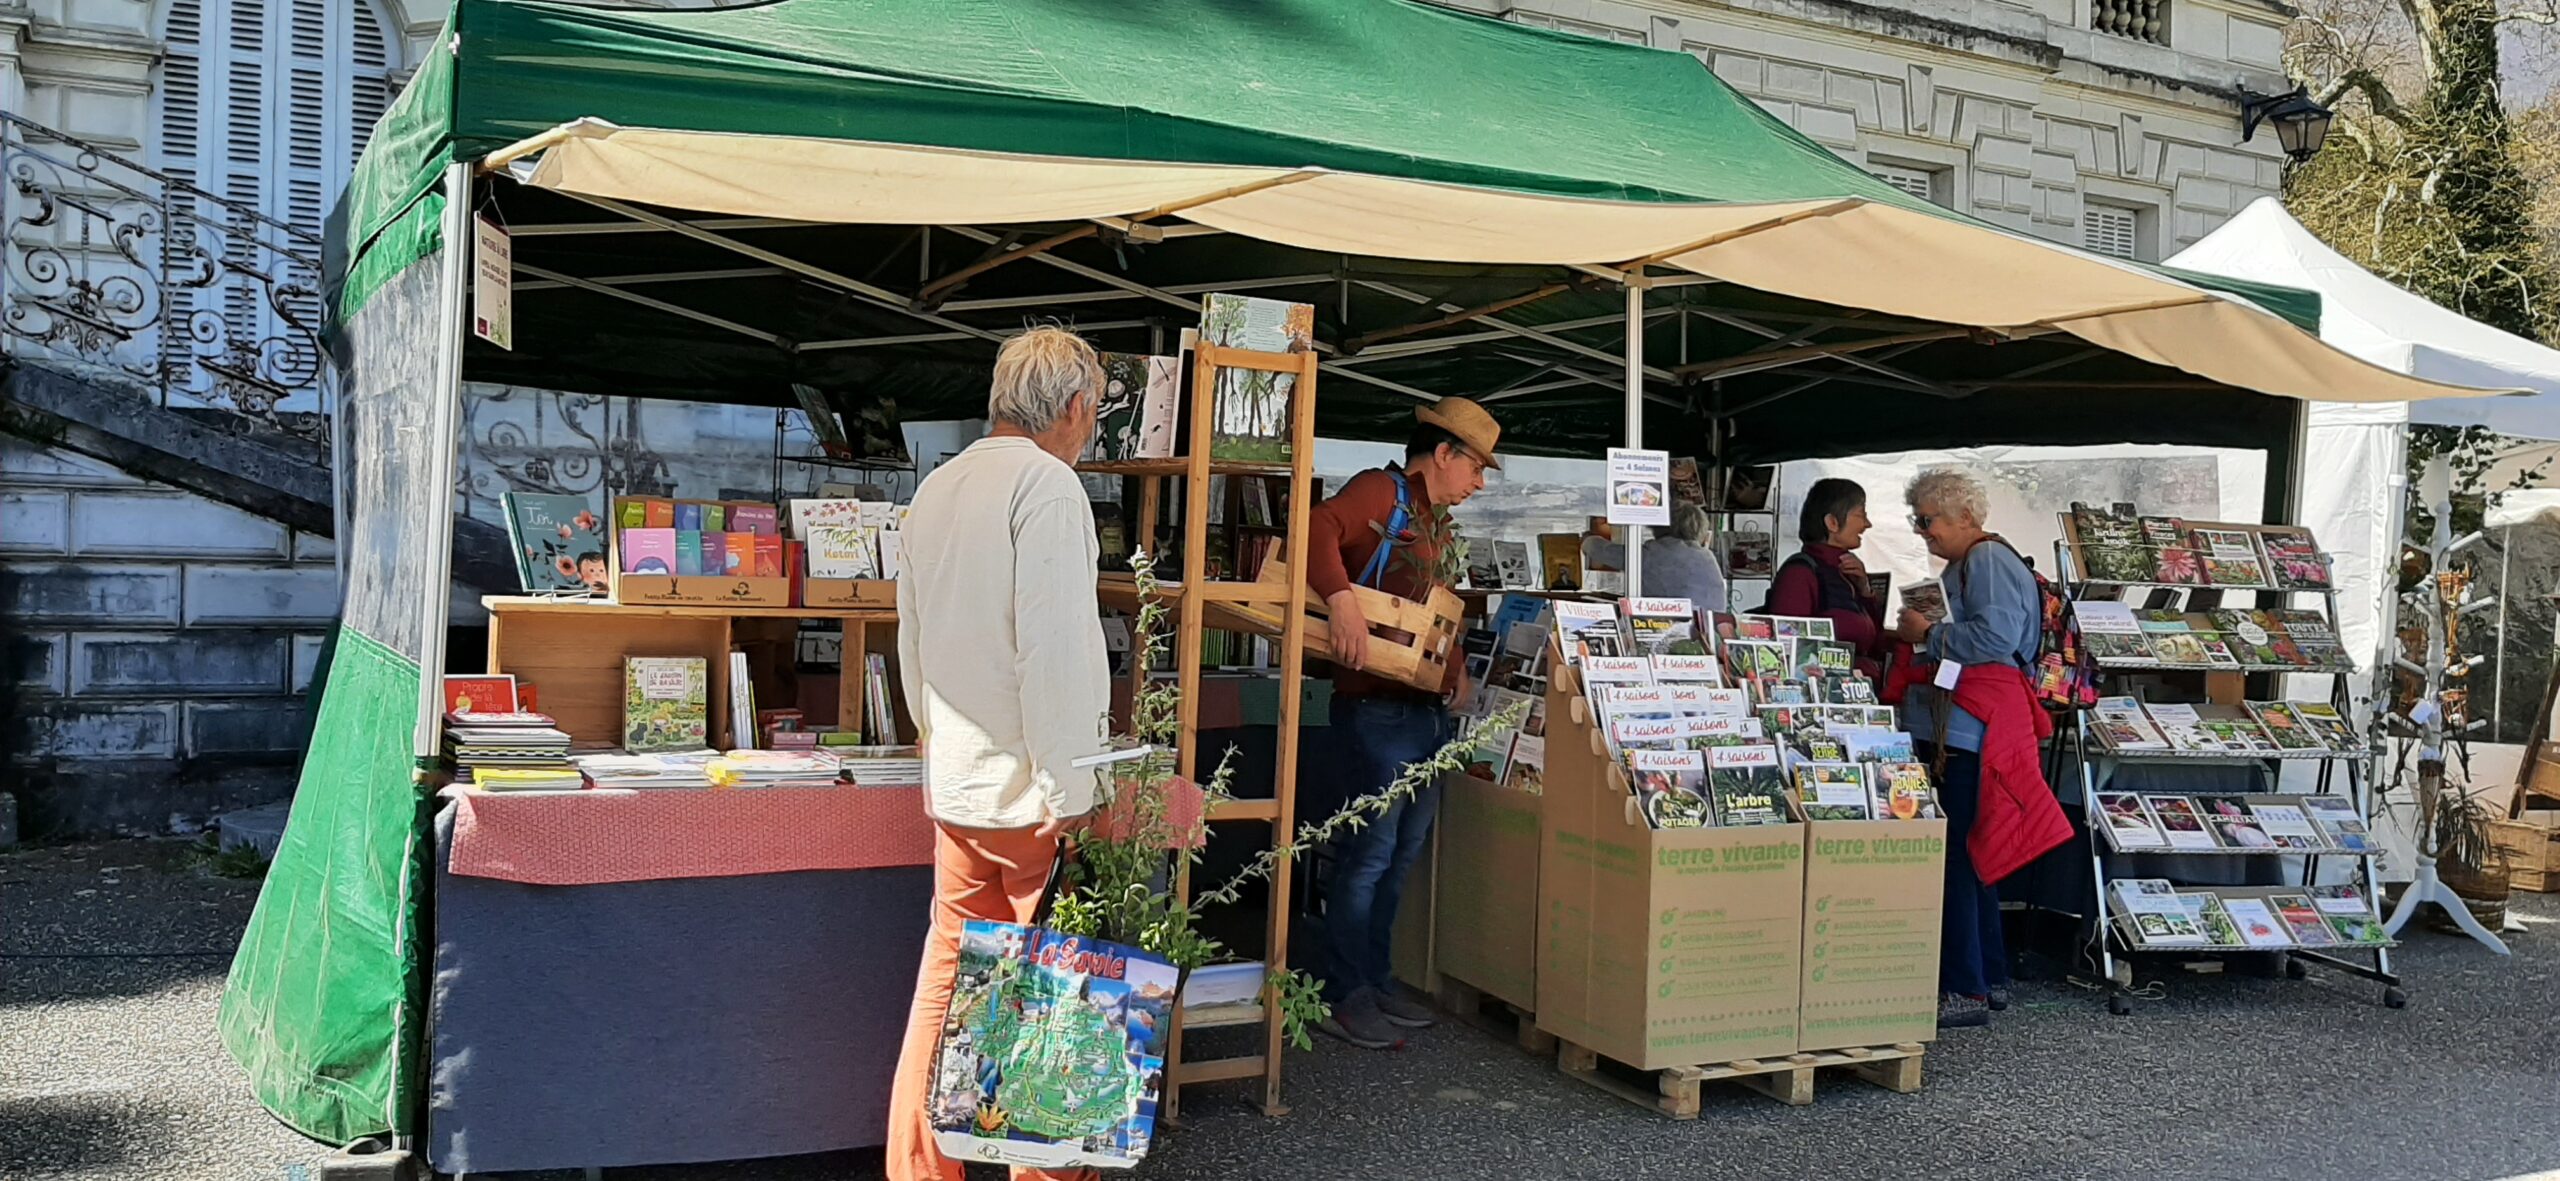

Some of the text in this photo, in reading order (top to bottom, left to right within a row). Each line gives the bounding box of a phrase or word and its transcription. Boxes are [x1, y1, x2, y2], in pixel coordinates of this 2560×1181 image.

[524, 507, 553, 526] Toi
[1565, 603, 1602, 620] Village
[1635, 600, 1684, 613] 4 saisons
[1593, 660, 1639, 671] 4 saisons
[1660, 657, 1706, 669] 4 saisons
[1615, 689, 1660, 701] 4 saisons
[1672, 689, 1696, 700] isons
[1841, 682, 1870, 699] STOP
[1623, 723, 1676, 736] 4 saisons
[1687, 718, 1729, 732] saisons
[1640, 753, 1693, 766] 4 saisons
[1716, 750, 1766, 763] 4 saisons
[1726, 792, 1772, 808] L'arbre
[1815, 833, 1943, 856] terre vivante
[1658, 846, 1715, 866] terre
[1722, 841, 1800, 863] vivante
[1029, 929, 1126, 979] La Savoie
[1806, 1010, 1937, 1030] www.terrevivante.org
[1651, 1024, 1795, 1048] www.terrevivante.org
